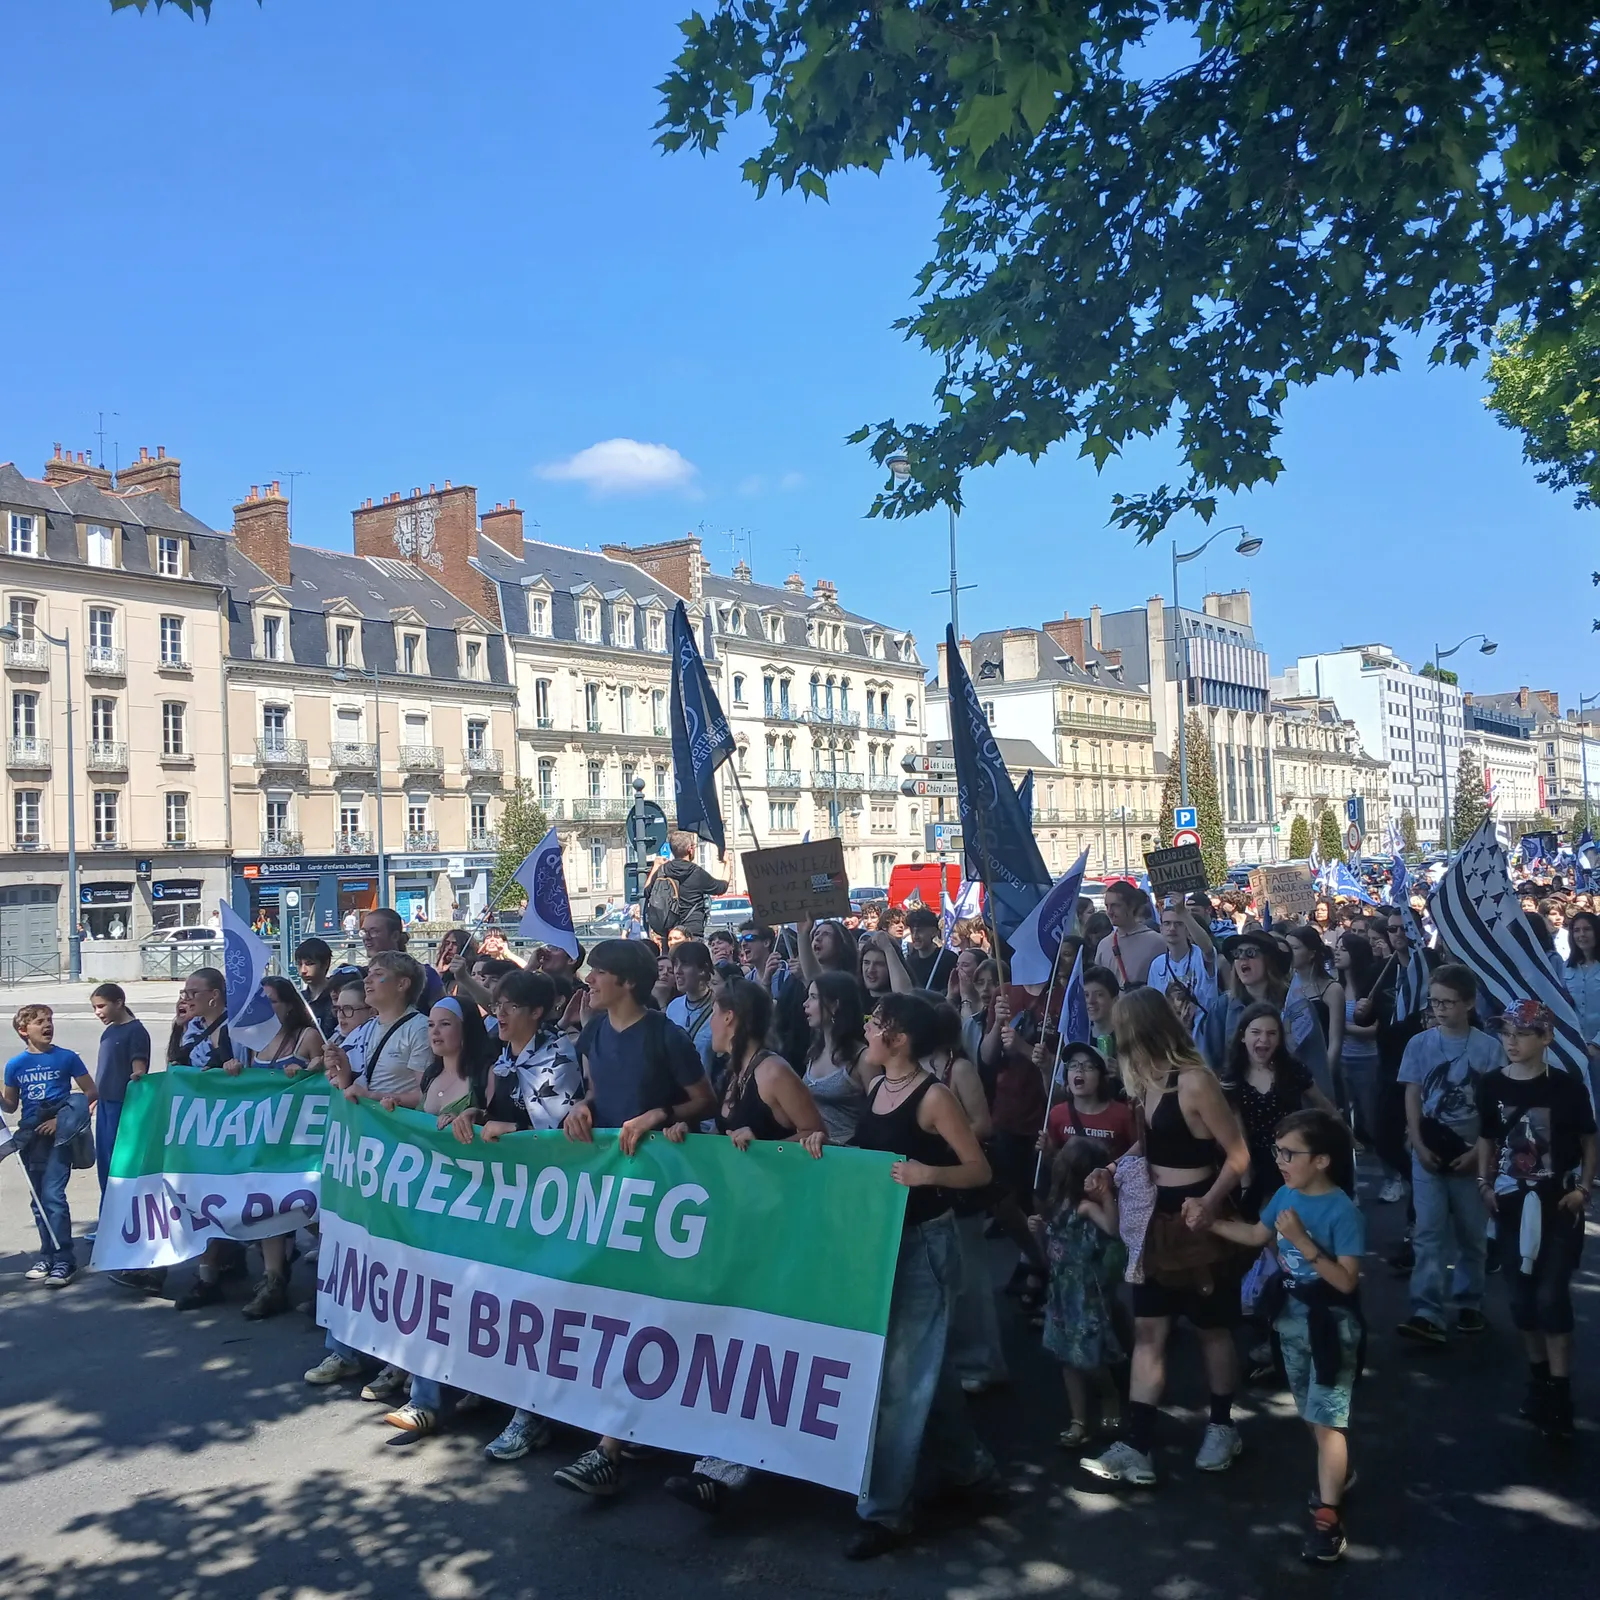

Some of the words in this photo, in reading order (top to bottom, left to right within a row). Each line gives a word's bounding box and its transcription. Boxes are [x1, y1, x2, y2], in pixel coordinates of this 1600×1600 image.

[930, 761, 940, 769] Les
[926, 784, 941, 794] Chézy
[1181, 811, 1191, 825] P
[943, 826, 961, 834] Vilaine
[269, 863, 300, 871] assadia
[1251, 870, 1303, 887] EFFACER
[1266, 882, 1298, 895] LANGUE
[1256, 892, 1315, 907] COLONISER
[17, 1070, 60, 1084] VANNES
[1063, 1126, 1115, 1139] MICRAFT
[356, 1135, 711, 1259] BREZHONEG
[467, 1287, 852, 1441] BRETONNE
